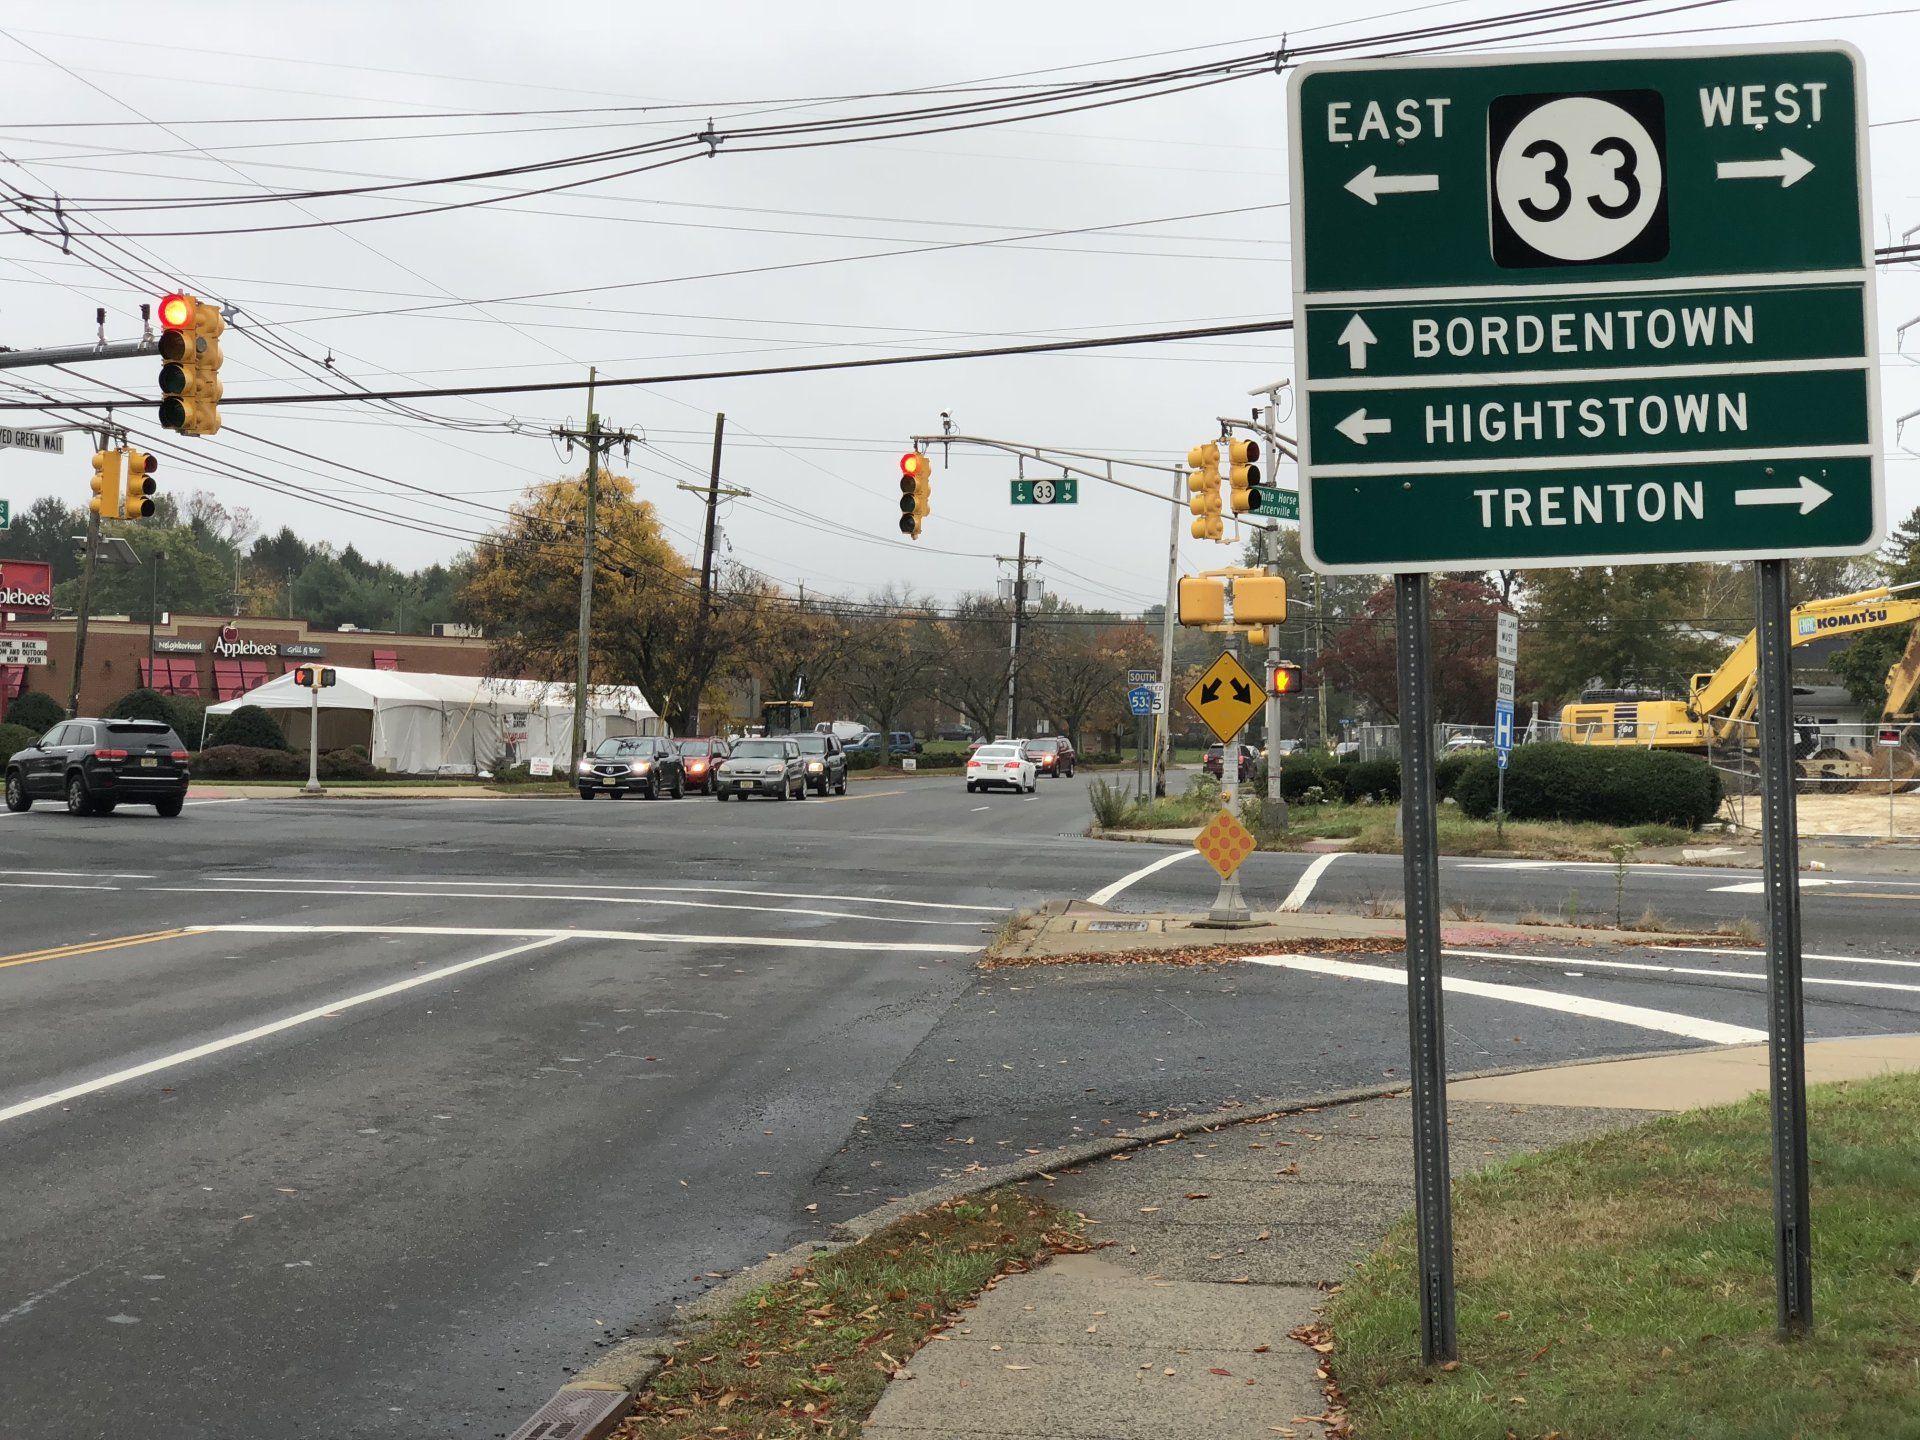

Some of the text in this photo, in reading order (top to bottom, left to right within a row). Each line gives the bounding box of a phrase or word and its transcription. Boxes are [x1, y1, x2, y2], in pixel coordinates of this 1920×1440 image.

[1699, 82, 1827, 128] WEST
[1327, 98, 1451, 142] EAST
[1517, 136, 1641, 222] 33
[1412, 305, 1754, 358] BORDENTOWN
[1425, 392, 1748, 444] HIGHTSTOWN
[15, 431, 40, 449] GREEN
[44, 435, 63, 451] WAIT
[1018, 483, 1023, 492] E
[1036, 485, 1052, 499] 33
[1064, 482, 1071, 491] W
[1260, 490, 1297, 505] hite Horse
[1473, 481, 1704, 528] TRENTON
[1255, 504, 1291, 517] ercerville
[1817, 608, 1887, 629] KOMATSU
[1502, 632, 1513, 643] MUST
[22, 641, 36, 649] BACK
[158, 640, 202, 651] Neighborhood
[214, 636, 277, 658] Applebee's
[287, 645, 302, 654] Grill
[309, 646, 321, 654] Bar
[22, 649, 48, 657] OUTDOOR
[27, 656, 42, 664] OPEN
[1130, 673, 1155, 682] SOUTH
[1498, 667, 1514, 681] DELAYED
[1500, 682, 1512, 695] GREEN
[1497, 711, 1511, 748] H
